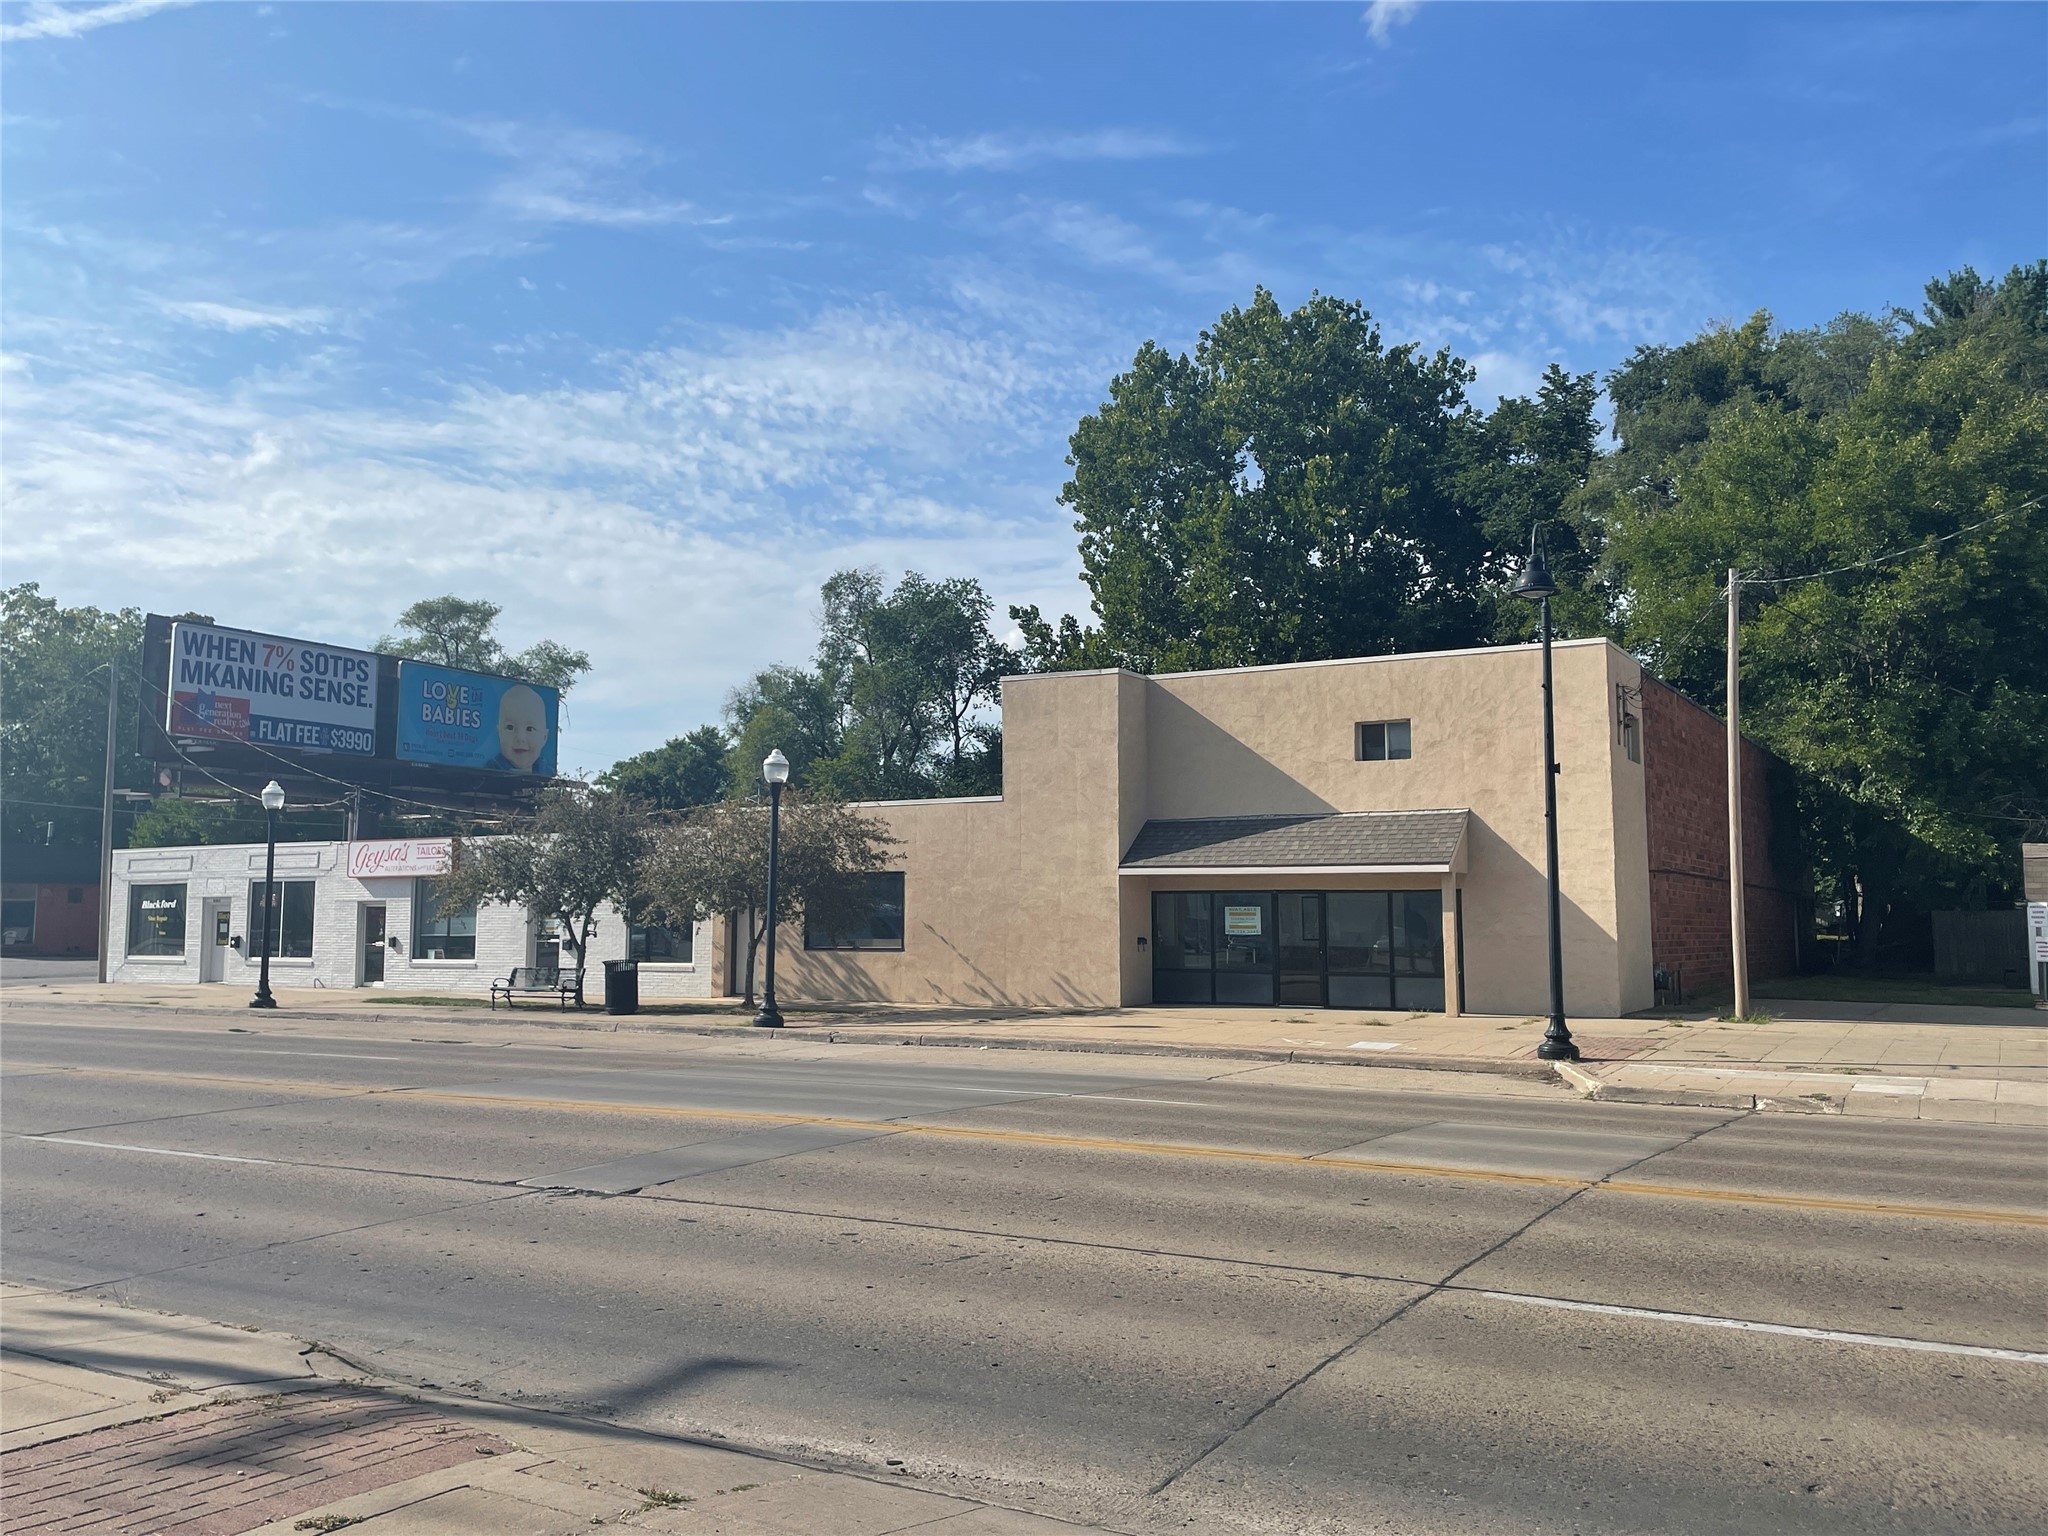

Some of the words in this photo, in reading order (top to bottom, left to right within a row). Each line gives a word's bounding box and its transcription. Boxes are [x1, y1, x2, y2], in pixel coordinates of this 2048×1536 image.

[182, 630, 256, 665] WHEN
[262, 643, 295, 672] 7%
[300, 650, 369, 682] SOTPS
[180, 658, 294, 697] MKANING
[299, 676, 373, 709] SENSE.
[423, 679, 469, 704] LOVE
[199, 703, 242, 718] generation
[214, 701, 232, 710] next
[422, 703, 481, 728] BABIES
[259, 720, 293, 742] FLAT
[295, 724, 320, 745] FEE
[330, 728, 372, 751] $3990
[352, 842, 410, 875] Geysa's
[417, 846, 446, 856] TAILORS
